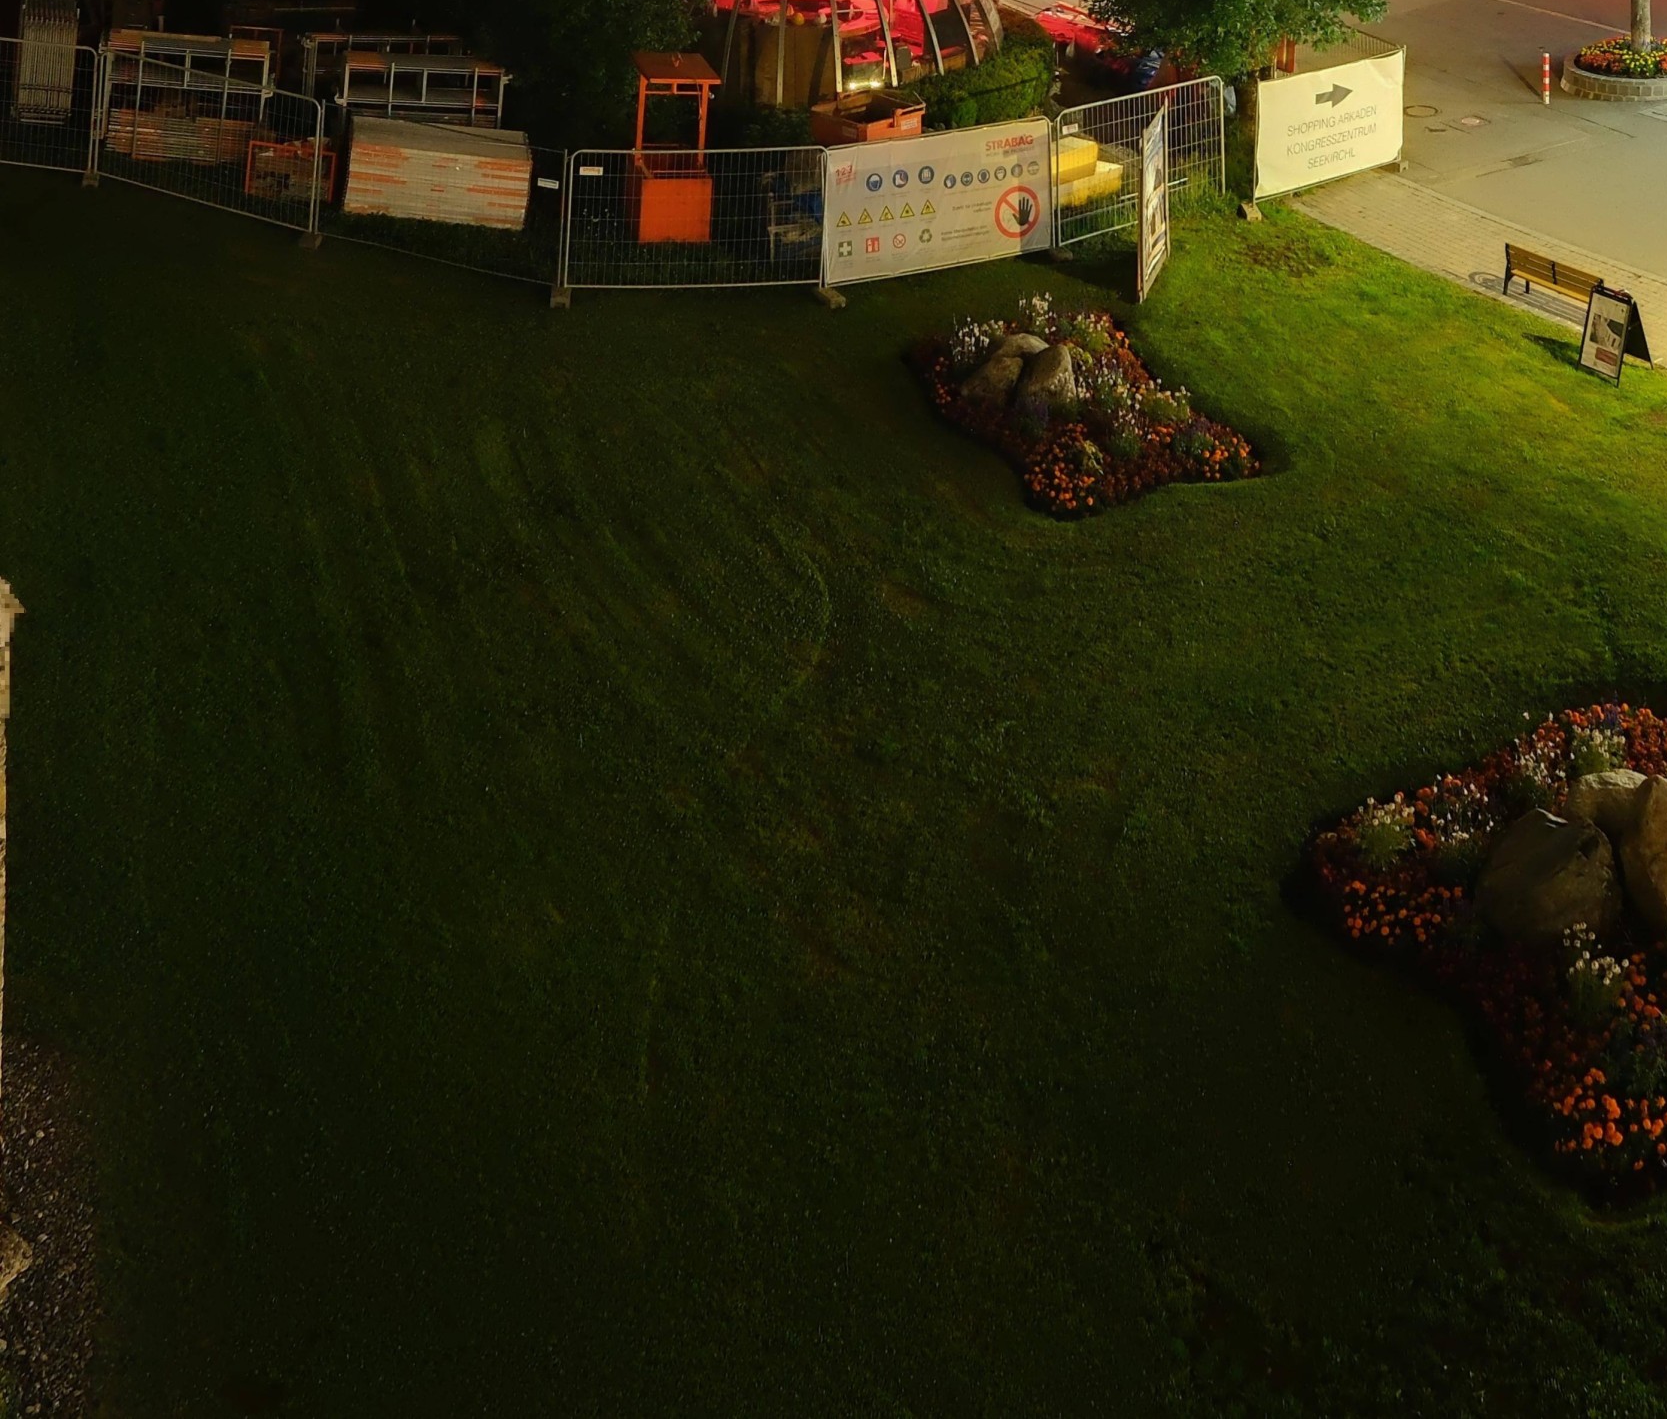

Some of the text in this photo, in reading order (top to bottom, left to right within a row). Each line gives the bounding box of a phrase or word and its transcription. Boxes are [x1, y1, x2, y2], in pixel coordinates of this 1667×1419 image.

[1287, 105, 1377, 137] SHOPPING ARKADEN
[985, 134, 1034, 152] STRABAG
[1286, 123, 1377, 157] KONGRESSZENTRUM
[1307, 147, 1356, 170] SEEKIRCHL
